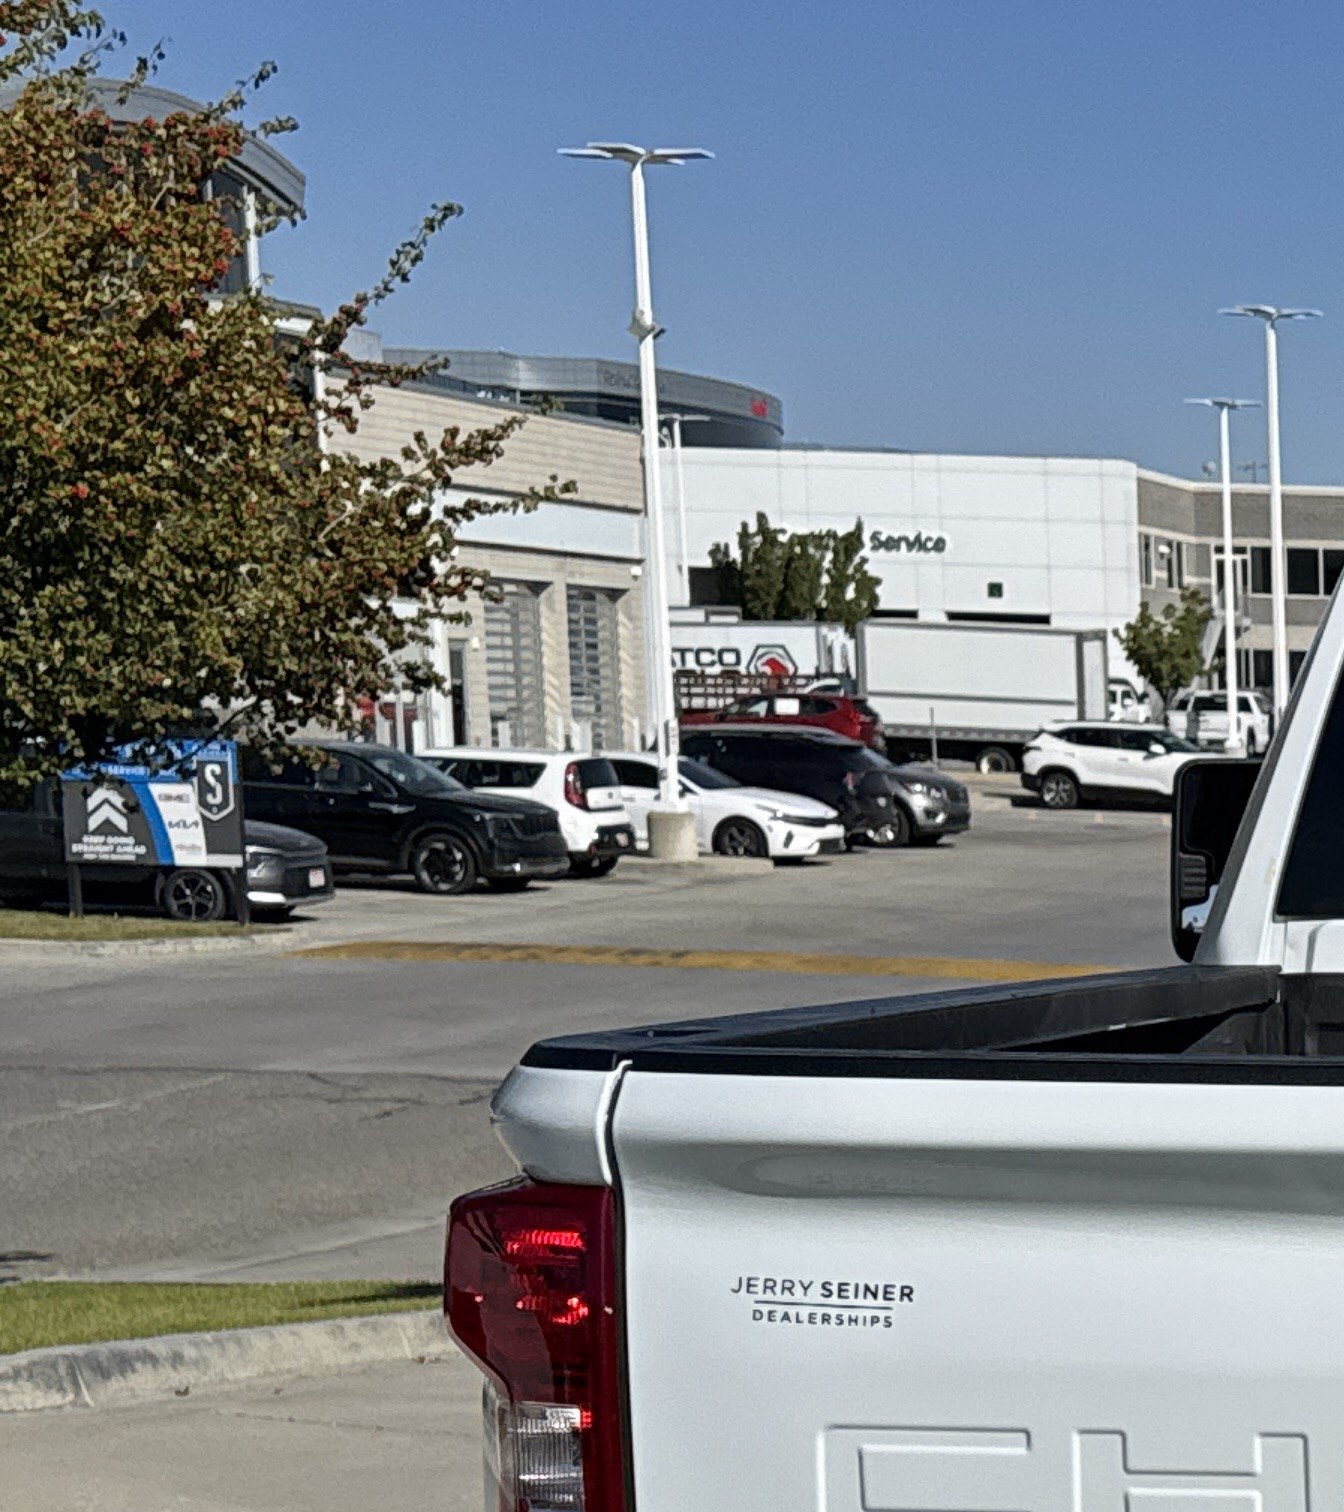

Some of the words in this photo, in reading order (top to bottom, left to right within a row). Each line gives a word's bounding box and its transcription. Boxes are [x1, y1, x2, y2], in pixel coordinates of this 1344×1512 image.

[869, 530, 947, 553] Service
[731, 1276, 814, 1298] JERRY
[820, 1280, 915, 1303] SEINER
[752, 1309, 893, 1329] DEALERSHIPS
